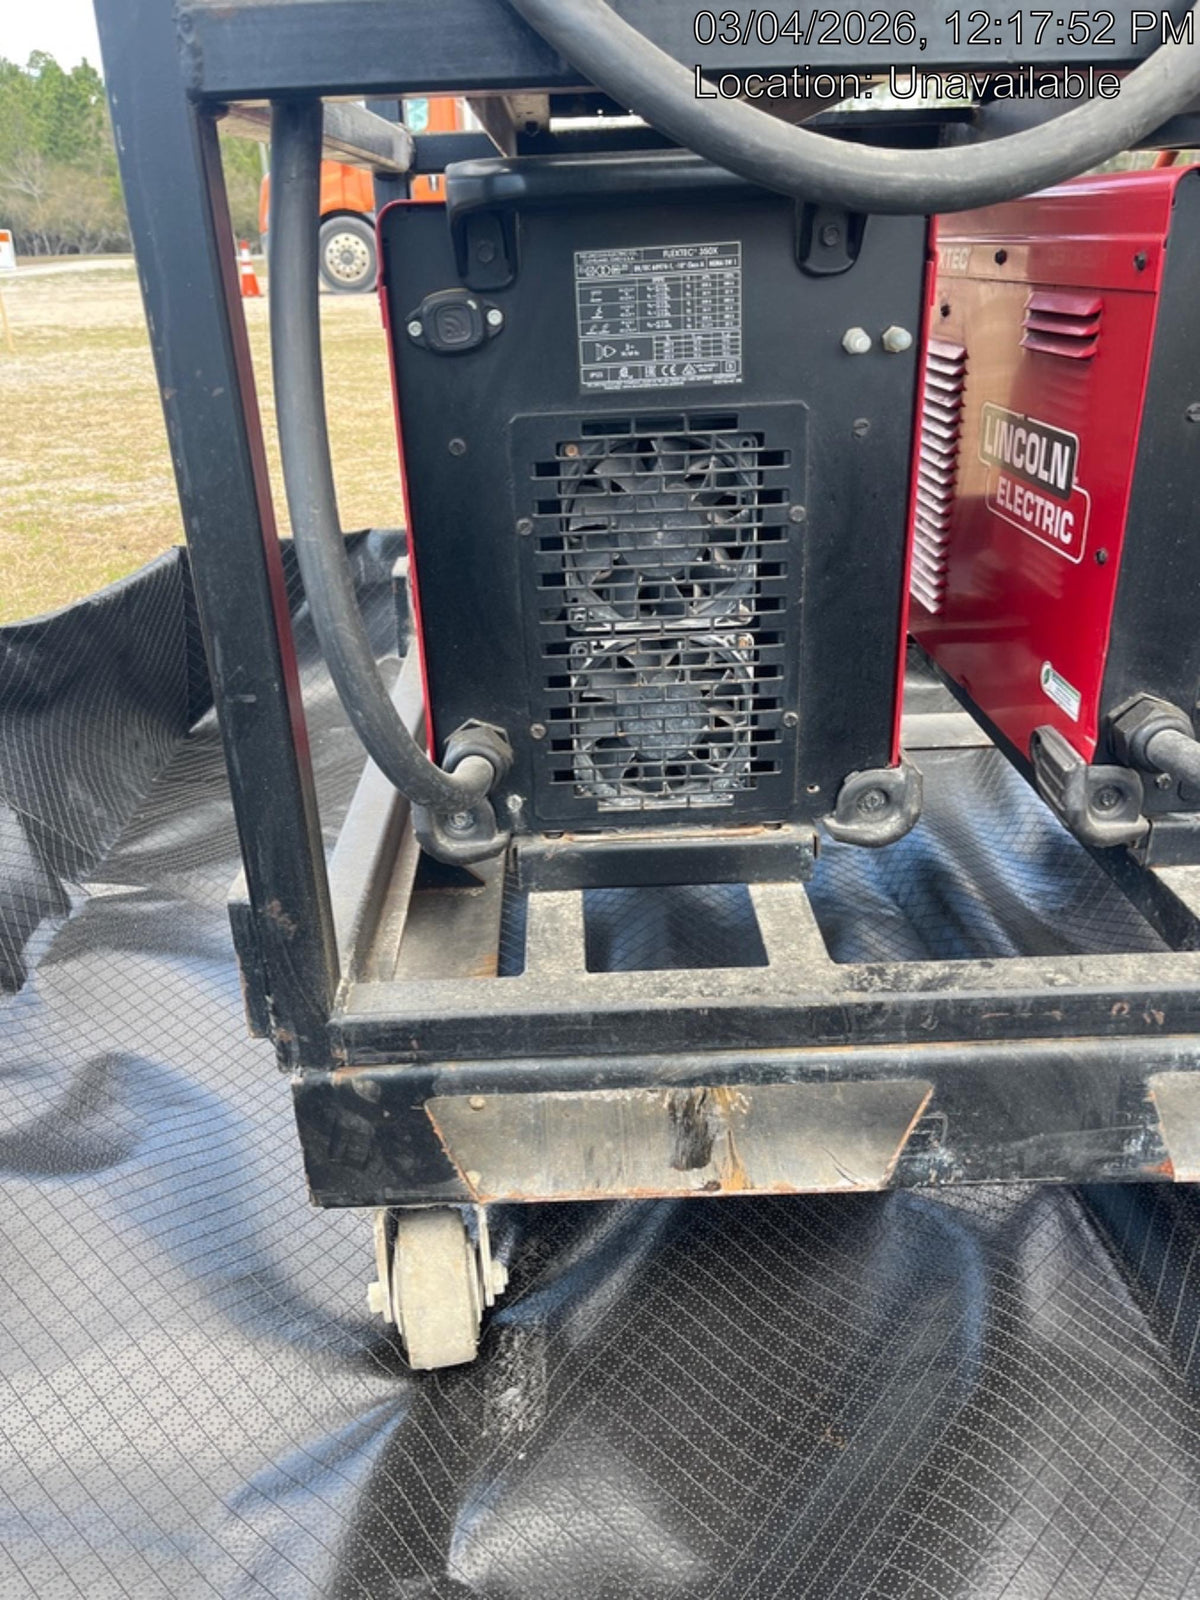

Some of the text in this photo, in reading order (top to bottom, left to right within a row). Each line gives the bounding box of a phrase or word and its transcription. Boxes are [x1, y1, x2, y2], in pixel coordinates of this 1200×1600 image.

[937, 247, 968, 270] XTEC
[983, 414, 1070, 491] LINCOLN
[997, 476, 1075, 545] ELECTRIC
